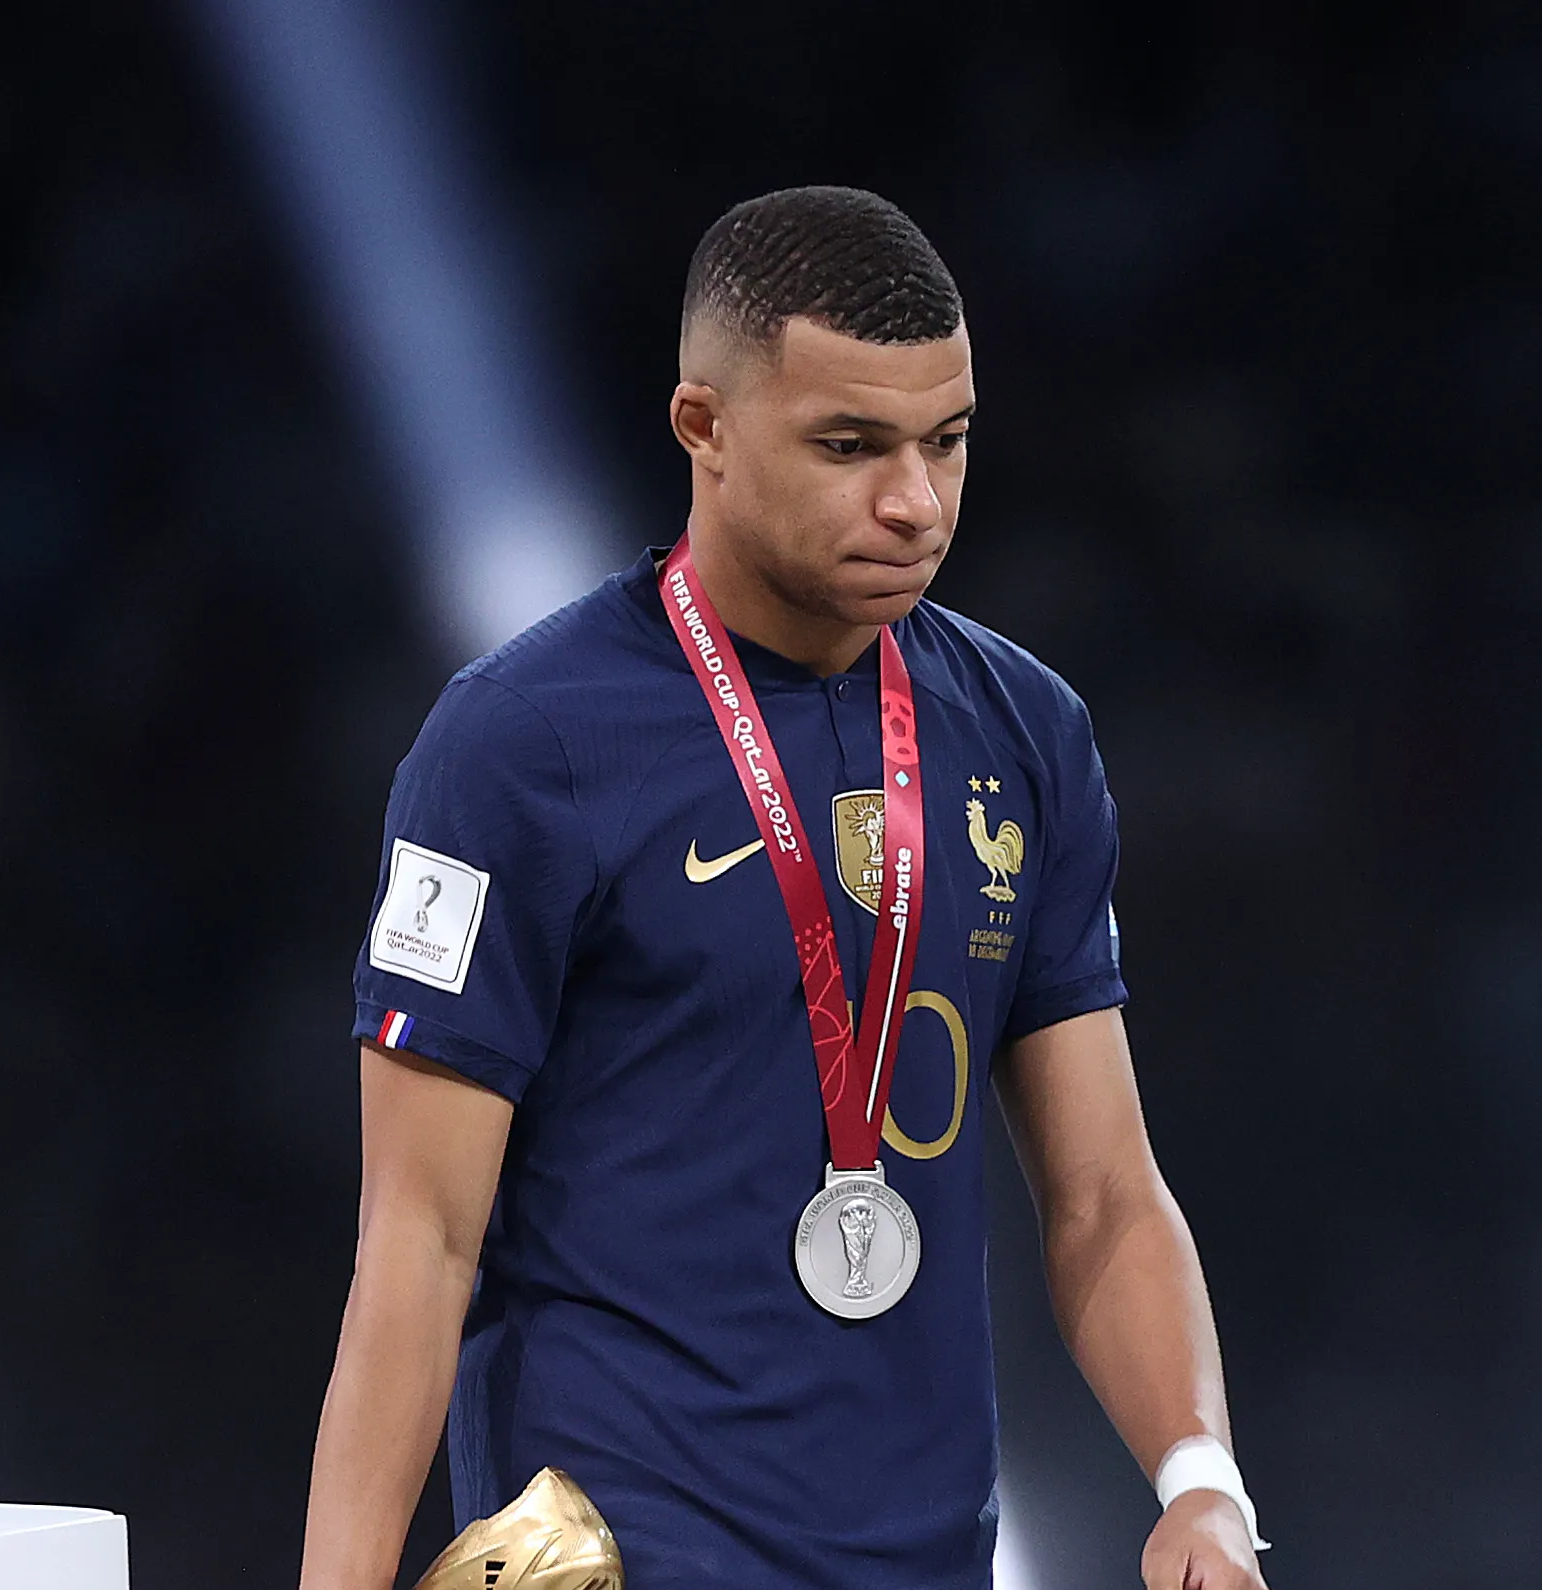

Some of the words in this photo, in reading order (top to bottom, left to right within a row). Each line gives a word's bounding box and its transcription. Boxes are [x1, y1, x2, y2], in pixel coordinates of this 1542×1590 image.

[669, 569, 694, 612] FIFA
[682, 605, 724, 673] WORLD
[386, 929, 403, 939] FIFA
[404, 933, 432, 949] WORLD
[432, 943, 450, 954] CUP
